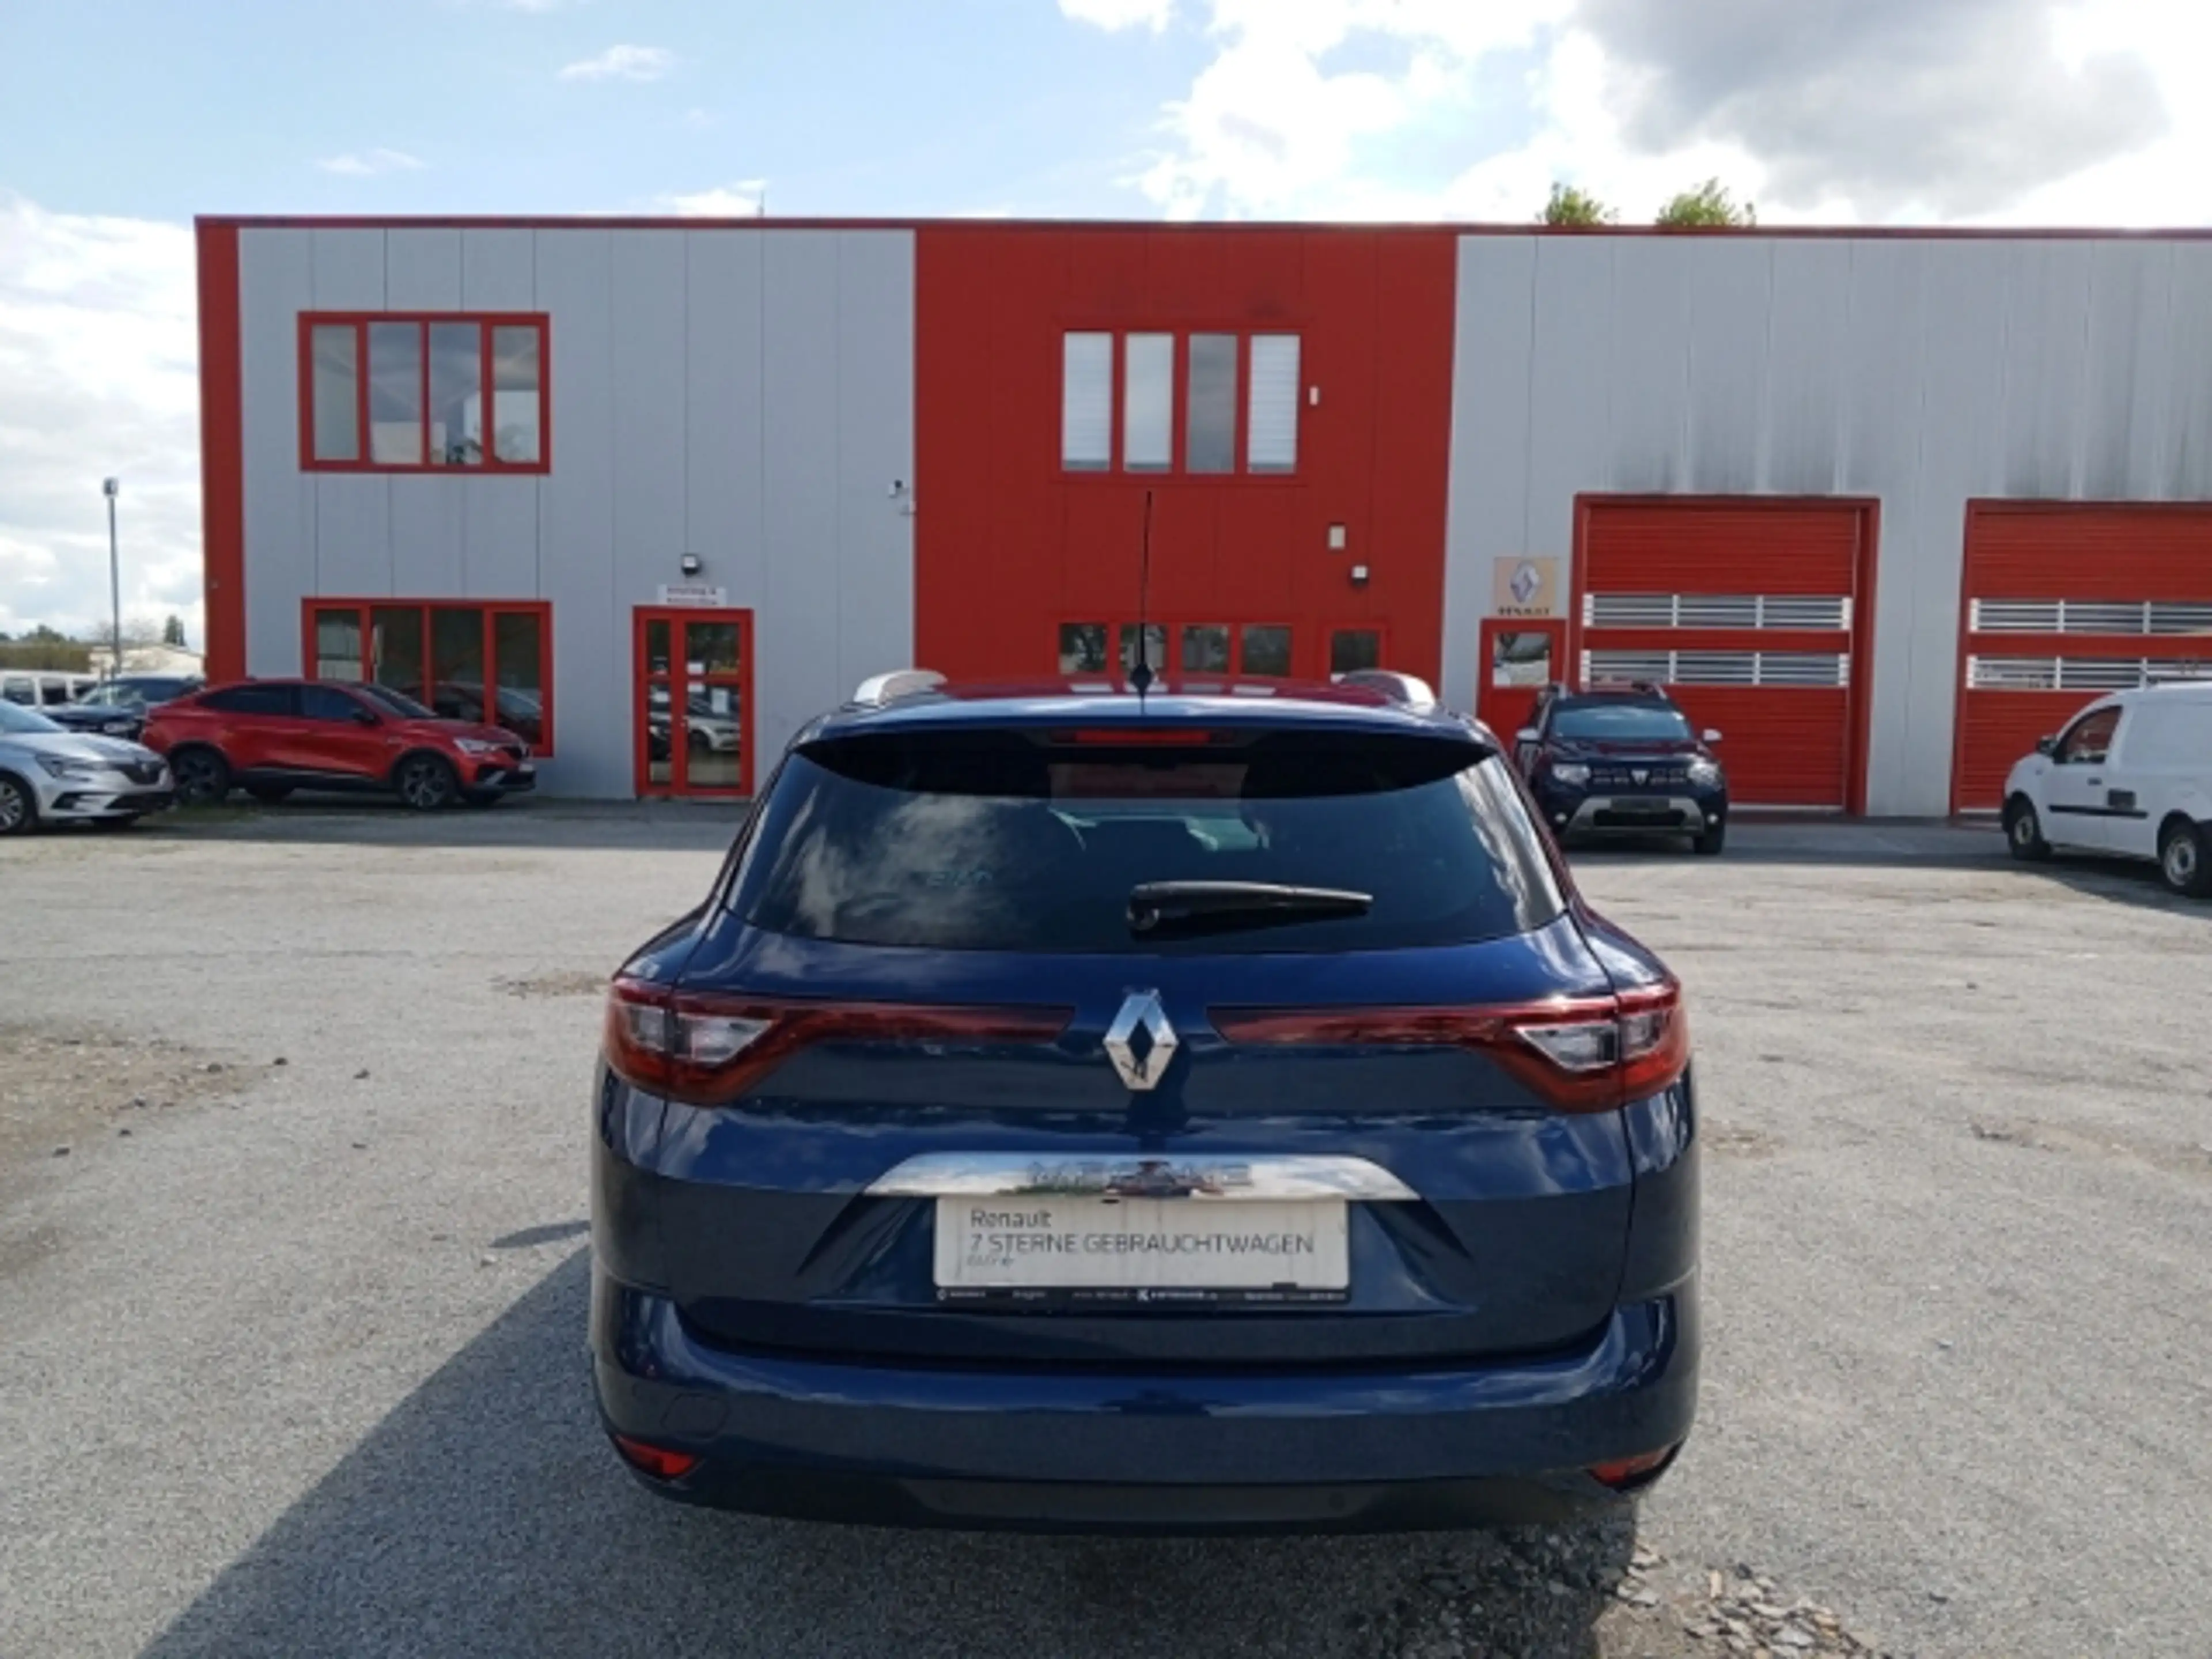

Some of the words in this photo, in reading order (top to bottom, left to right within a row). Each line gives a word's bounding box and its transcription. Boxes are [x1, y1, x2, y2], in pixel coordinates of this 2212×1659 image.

[971, 1209, 1052, 1228] Renault
[971, 1233, 983, 1252] 7
[988, 1233, 1079, 1253] STERNE
[1083, 1233, 1315, 1254] GEBRAUCHTWAGEN
